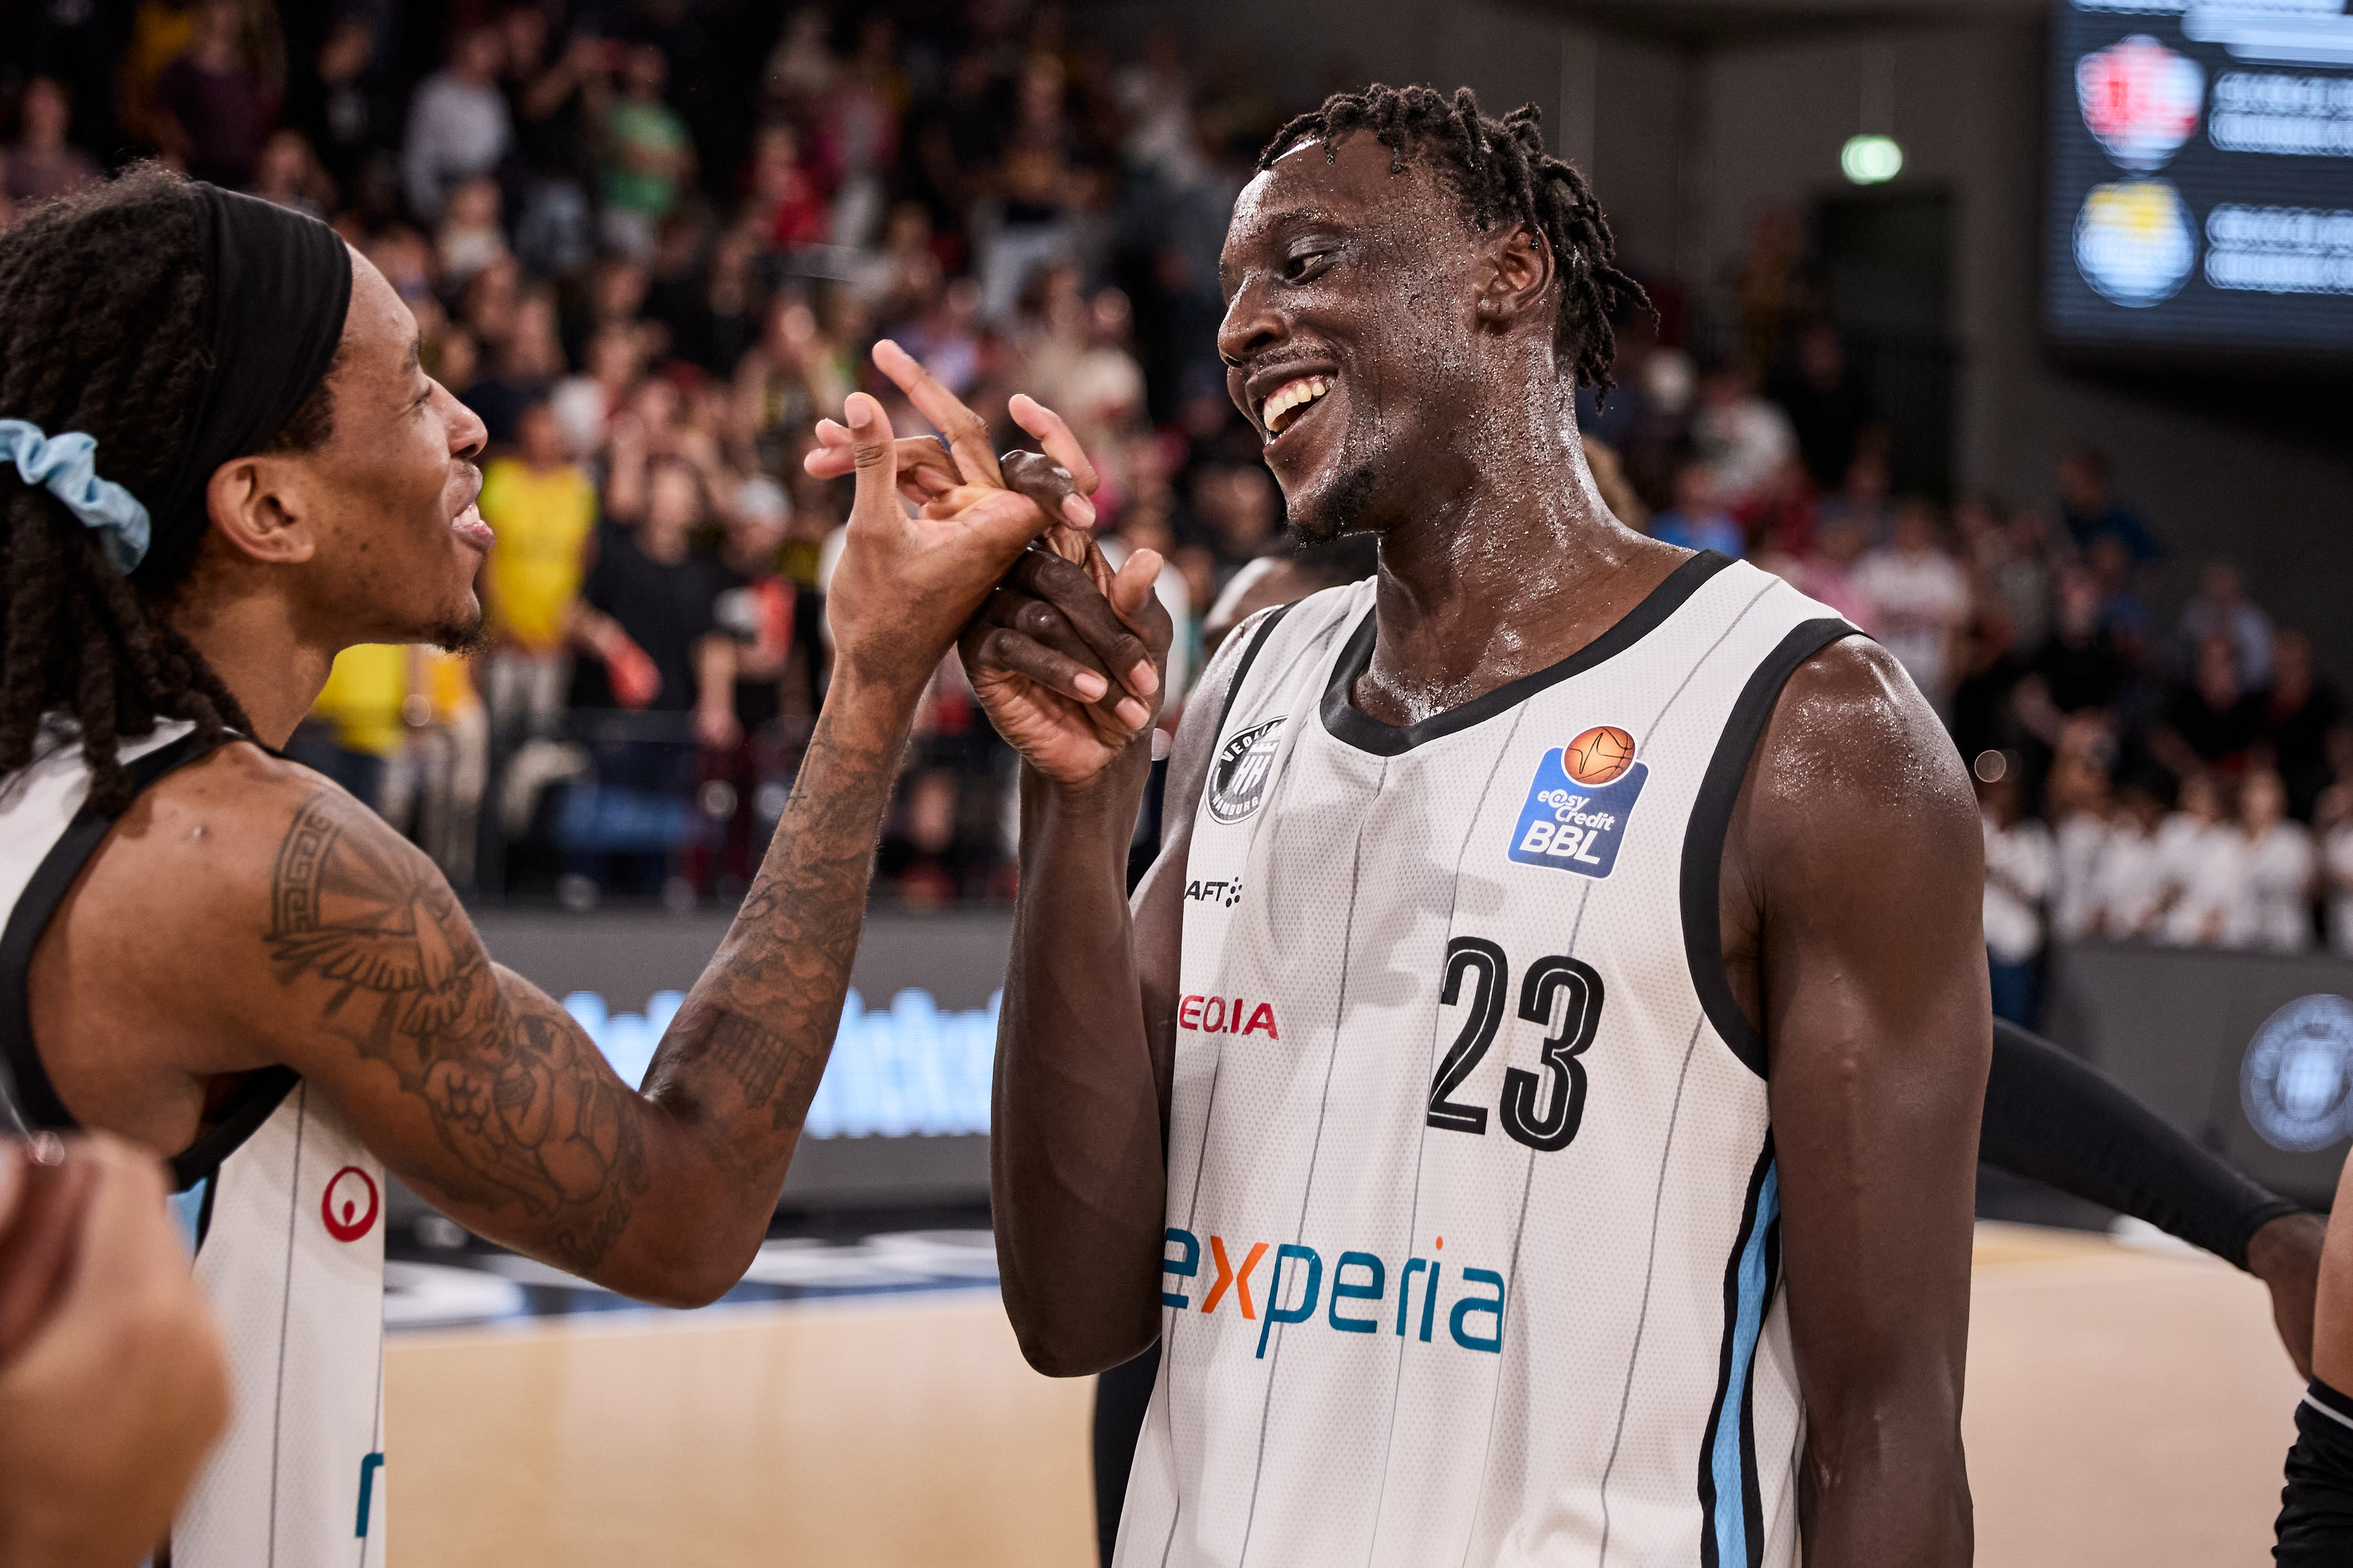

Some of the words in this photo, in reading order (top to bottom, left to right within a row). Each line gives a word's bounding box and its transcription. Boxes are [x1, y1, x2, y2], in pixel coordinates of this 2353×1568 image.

[1212, 794, 1259, 816] HAMBURG
[1555, 805, 1615, 832] Credit
[1519, 820, 1601, 865] BBL
[1426, 936, 1604, 1152] 23
